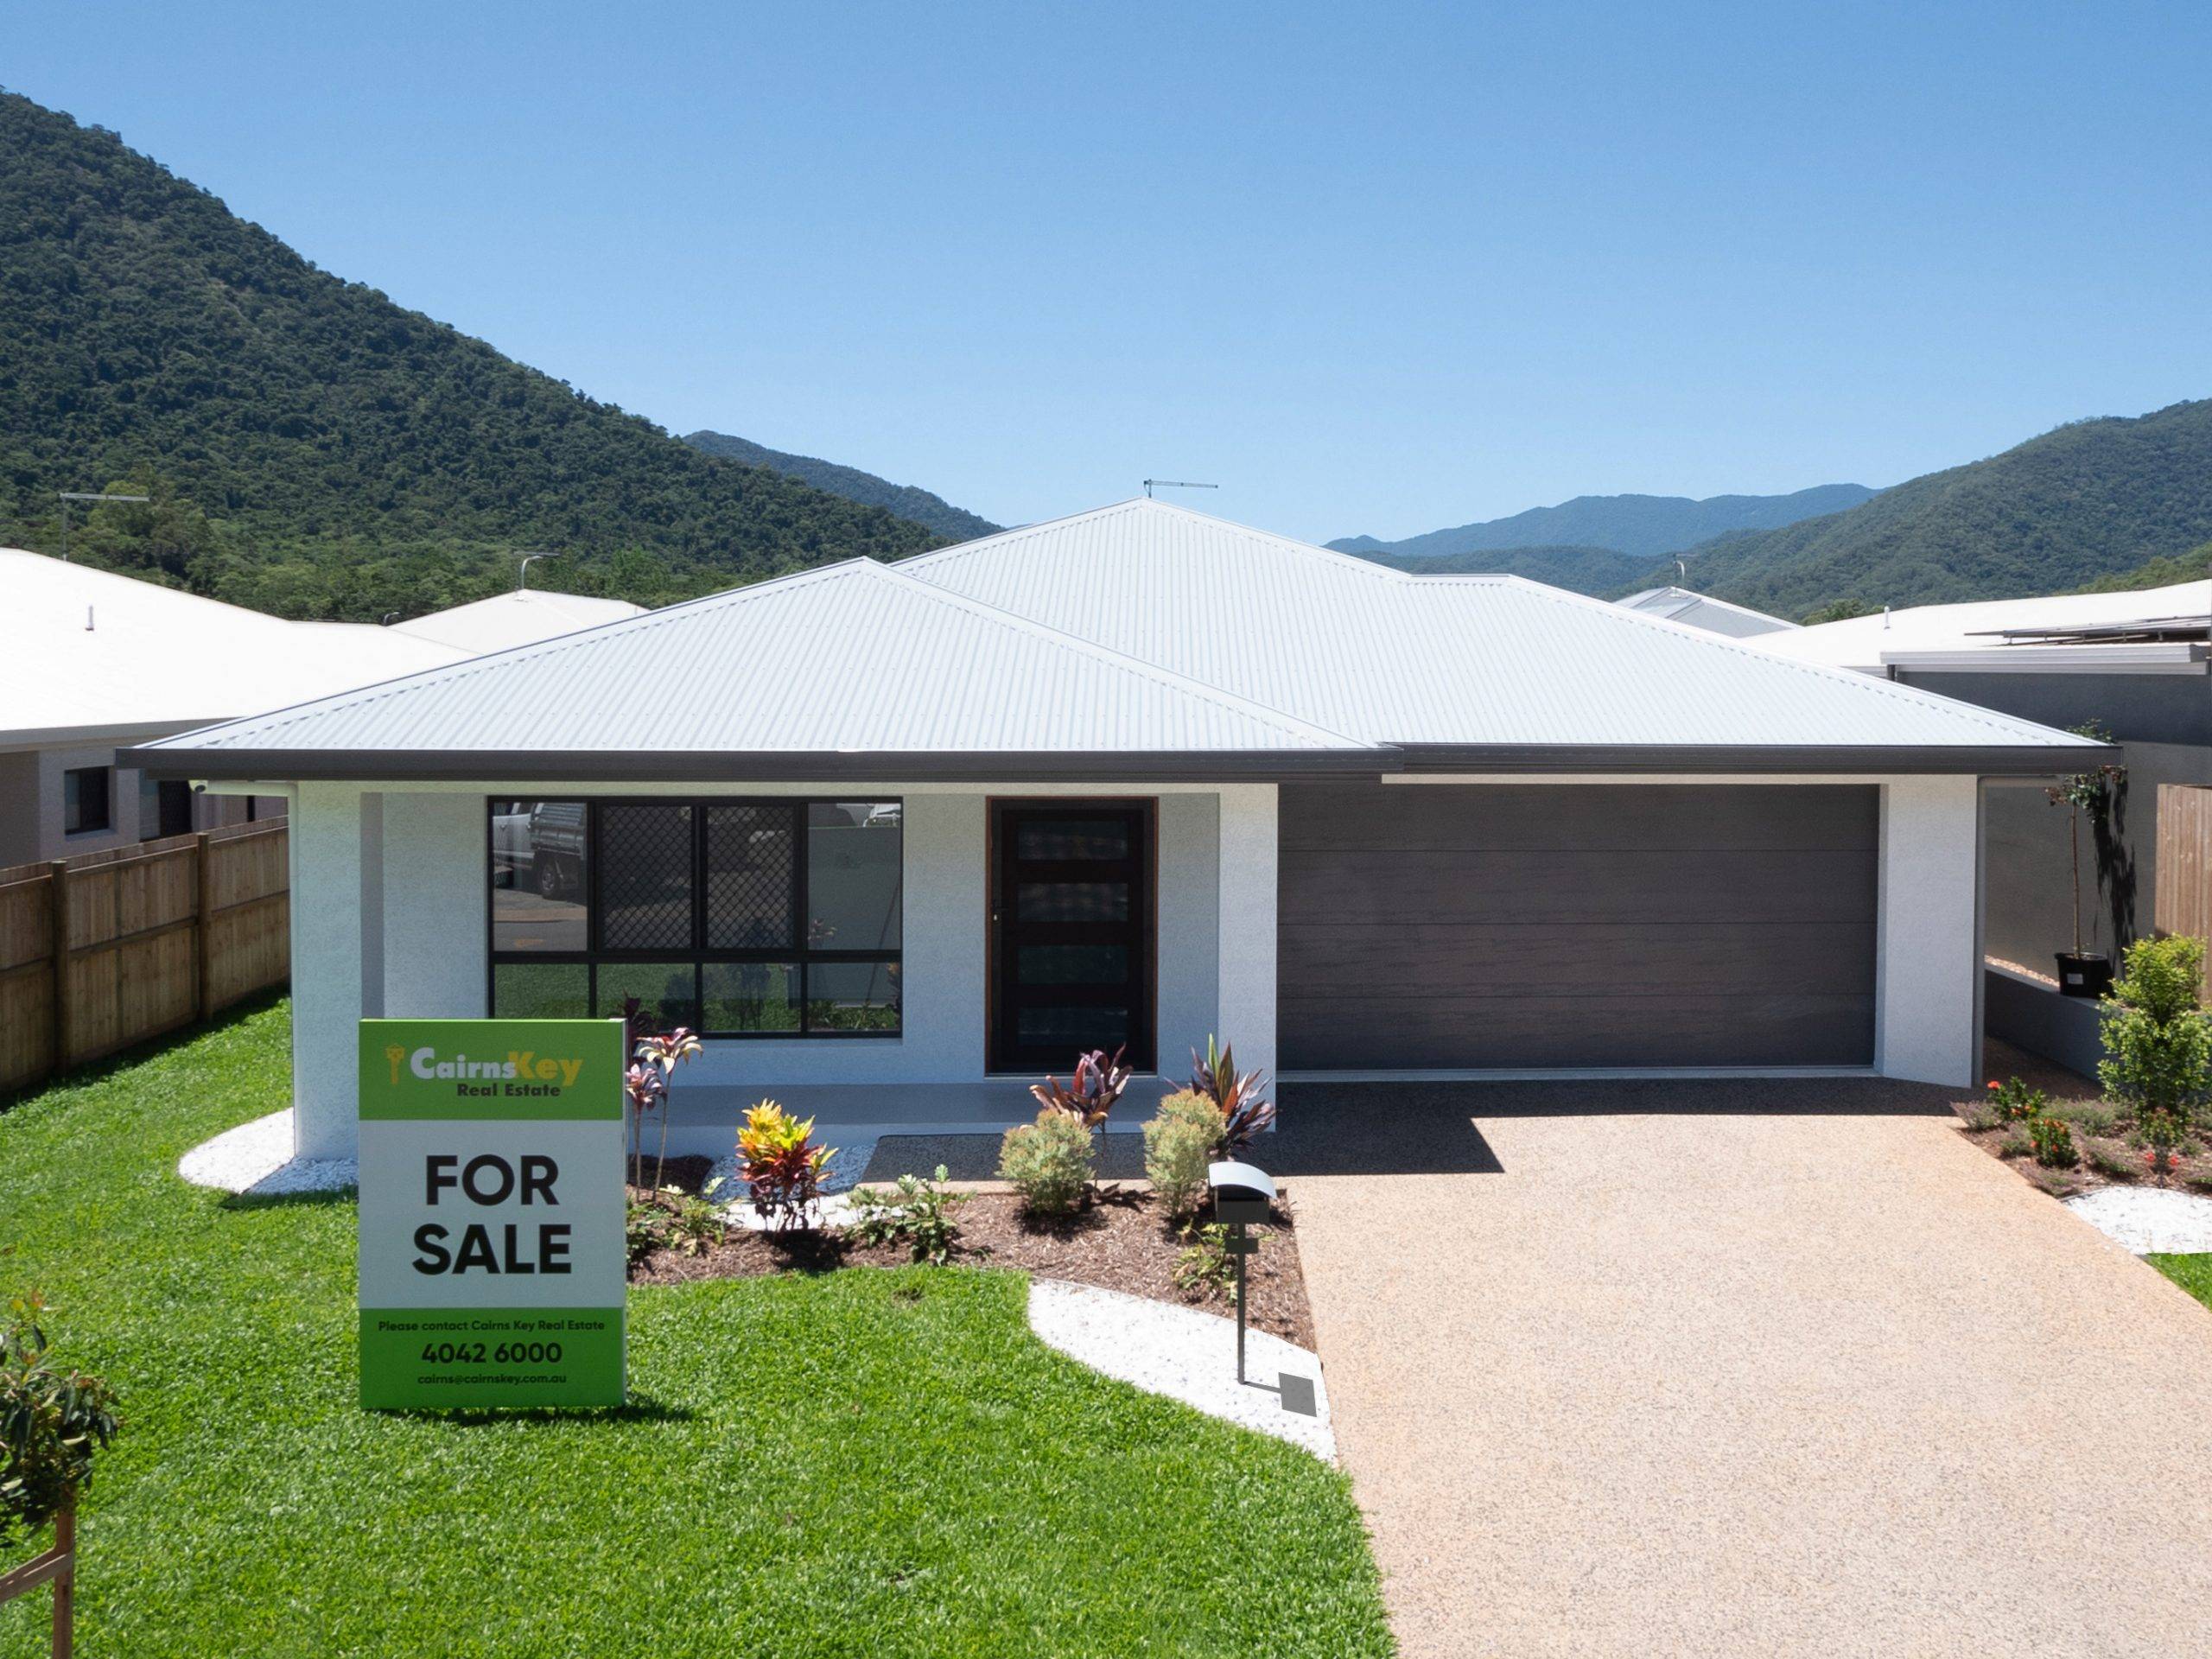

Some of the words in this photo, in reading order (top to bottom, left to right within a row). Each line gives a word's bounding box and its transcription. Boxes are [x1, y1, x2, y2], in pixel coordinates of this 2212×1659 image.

[410, 1046, 582, 1086] CairnsKey
[457, 1084, 498, 1096] Real
[505, 1084, 561, 1096] Estate
[426, 1154, 560, 1206] FOR
[412, 1224, 571, 1275] SALE
[378, 1321, 418, 1332] Please
[422, 1321, 468, 1332] contact
[471, 1320, 510, 1331] Cairns
[514, 1320, 535, 1332] Key
[538, 1320, 564, 1331] Real
[568, 1320, 605, 1331] Estate
[422, 1343, 486, 1363] 4042
[494, 1342, 563, 1363] 6000
[417, 1374, 567, 1385] cairns@cairnskey.com.au
